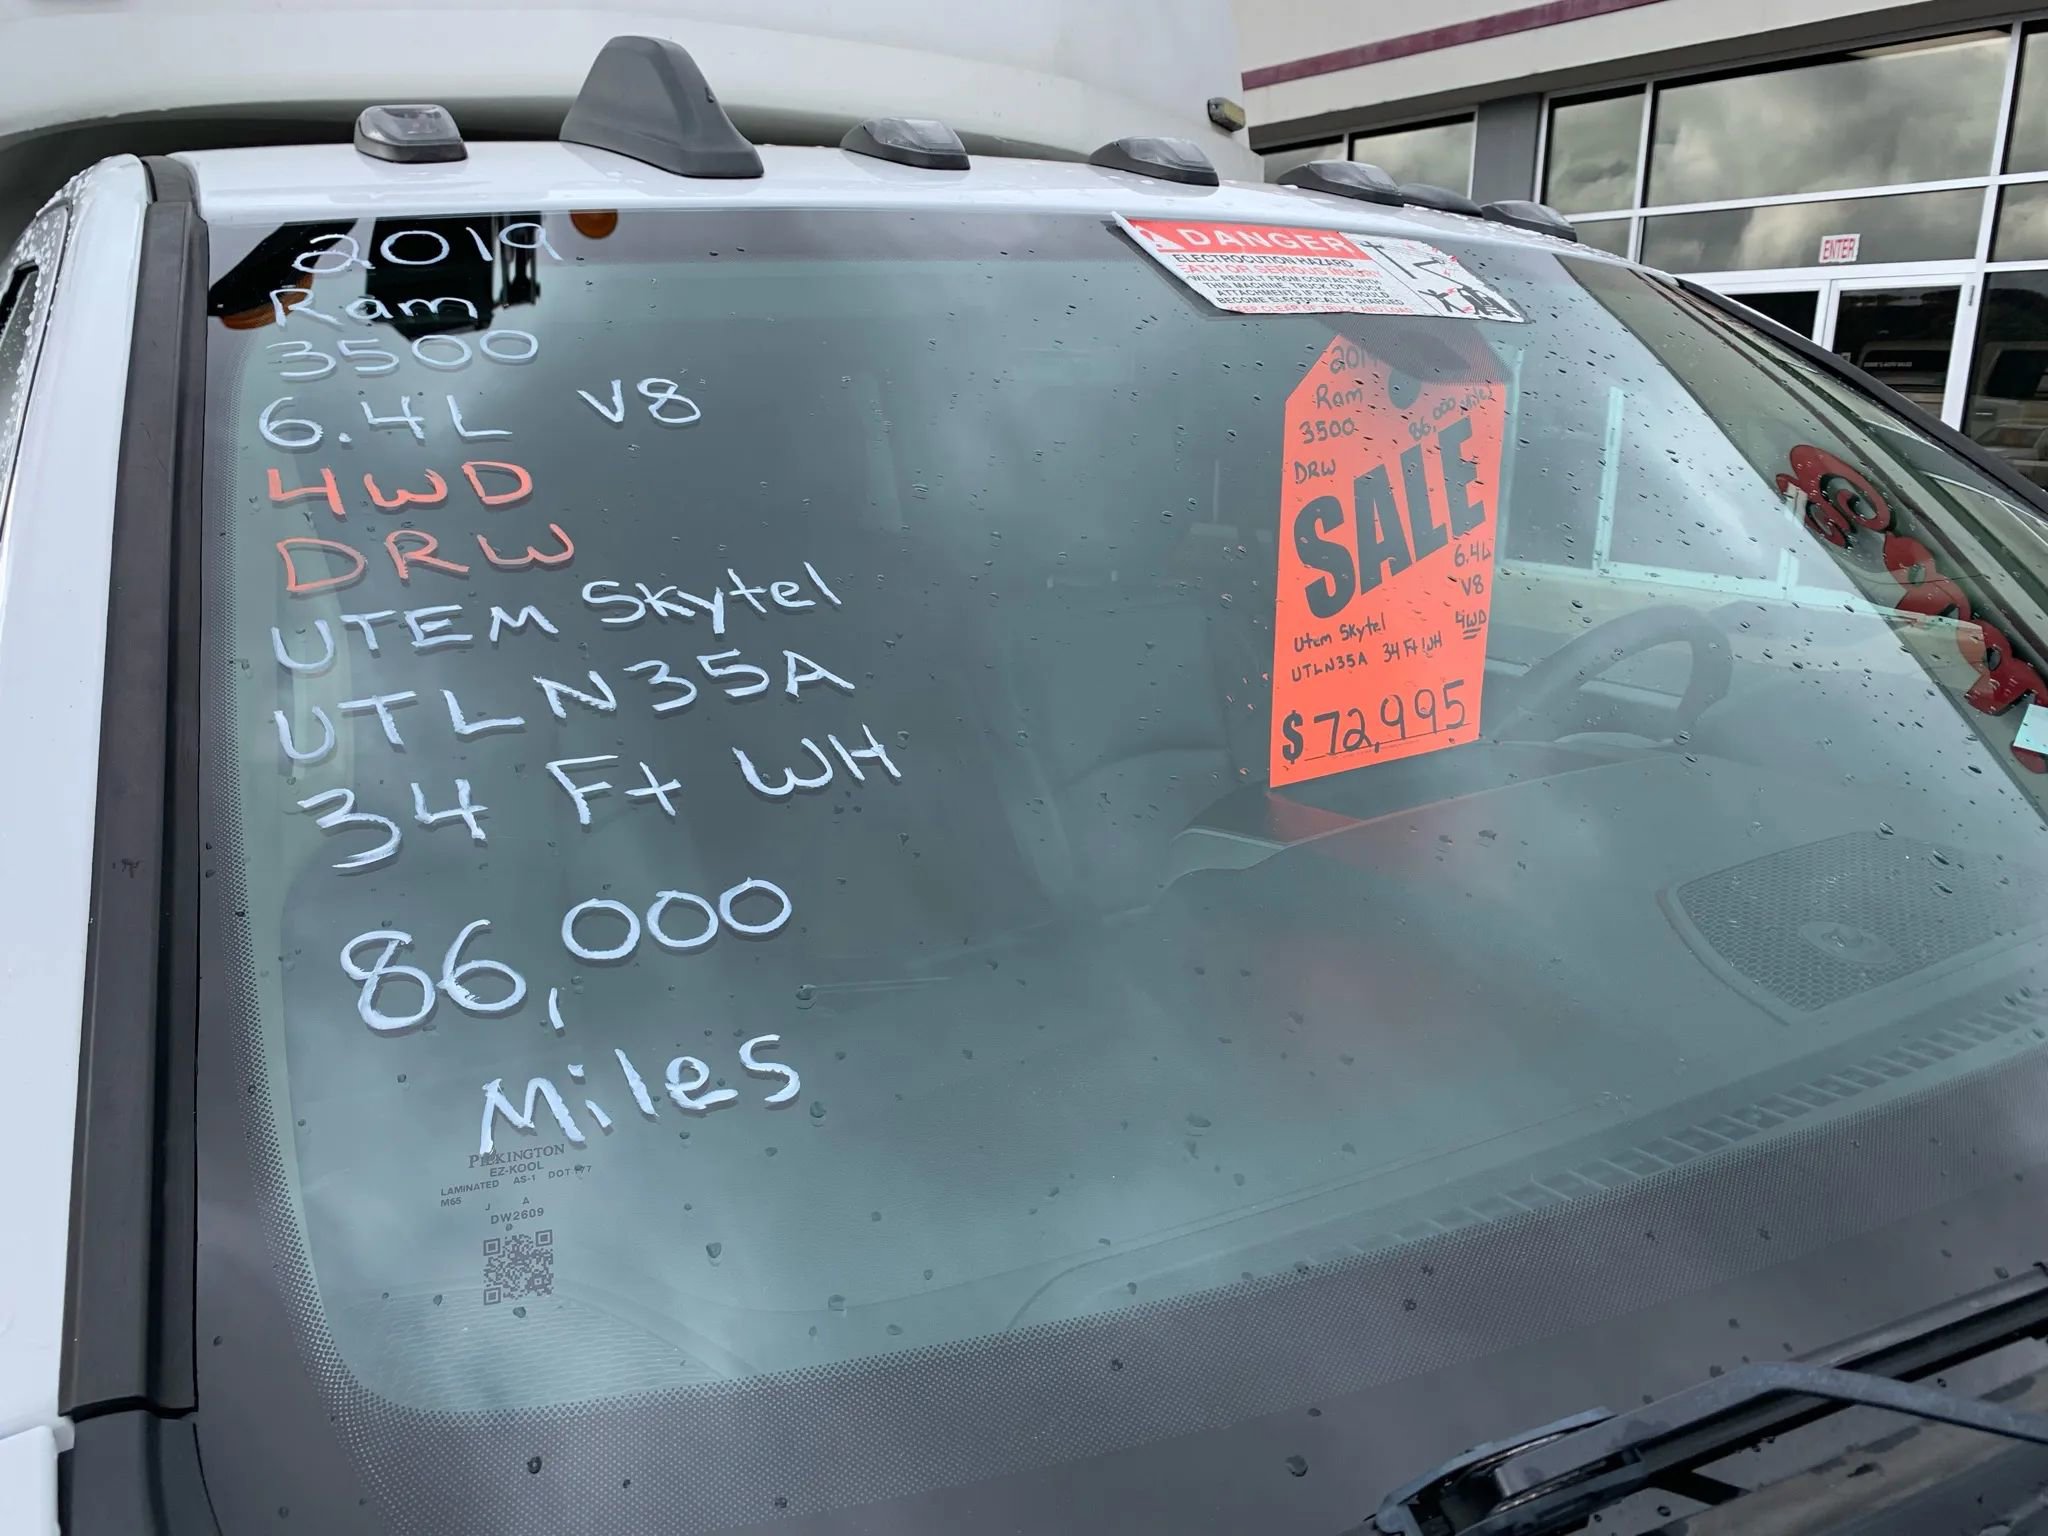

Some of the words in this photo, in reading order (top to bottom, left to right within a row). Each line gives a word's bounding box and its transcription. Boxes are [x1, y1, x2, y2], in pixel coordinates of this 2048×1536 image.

[293, 223, 563, 274] 2019
[1176, 228, 1355, 254] DANGER
[1823, 238, 1856, 260] ENTER
[1170, 253, 1297, 264] ELECTROCUTION
[1294, 256, 1355, 267] HAZARD
[1252, 265, 1330, 275] SERIOUS
[1300, 275, 1353, 283] CONTACT
[1343, 290, 1391, 298] SHOULD
[269, 288, 479, 327] Ram
[266, 330, 539, 379] 3500
[1316, 383, 1363, 409] Ram
[259, 396, 513, 447] 6.4L
[577, 378, 701, 424] V8
[1299, 418, 1356, 444] 3500
[1294, 459, 1336, 484] DRW
[267, 461, 533, 516] 4WD
[1293, 415, 1486, 618] SALE
[276, 523, 575, 593] DRW
[1460, 574, 1484, 596] V8
[1455, 609, 1487, 629] 4WD
[272, 604, 559, 671] UTEM
[1292, 651, 1368, 682] UTLN35A
[1382, 641, 1400, 663] 34
[297, 779, 489, 869] 34
[733, 723, 902, 796] WH
[340, 877, 793, 1030] 86,000
[480, 1034, 800, 1154] Miles
[440, 1180, 500, 1196] LAMINATED
[513, 1174, 536, 1185] AS-1
[548, 1169, 571, 1179] DOT
[489, 1161, 545, 1178] EZ-KOOL
[440, 1196, 462, 1207] M65
[490, 1207, 545, 1224] DW2609
